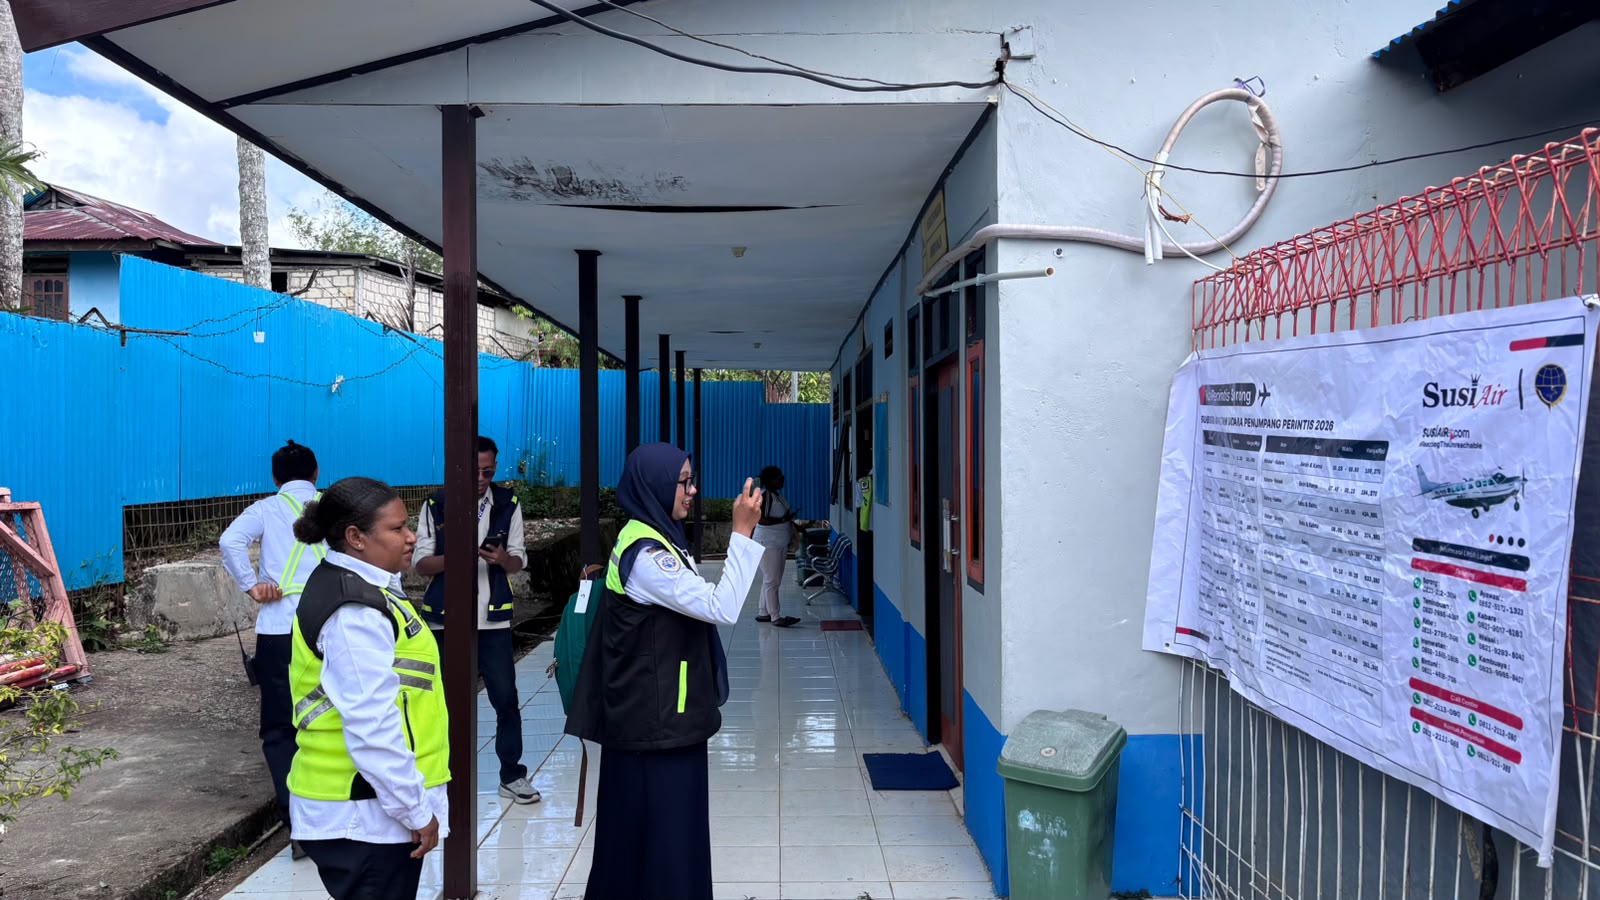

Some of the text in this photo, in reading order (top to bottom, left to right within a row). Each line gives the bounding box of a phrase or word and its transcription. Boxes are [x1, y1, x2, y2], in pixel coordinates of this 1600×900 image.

[1422, 382, 1508, 409] Susi Air
[1282, 419, 1315, 430] PERINTIS
[1315, 420, 1335, 431] 2026
